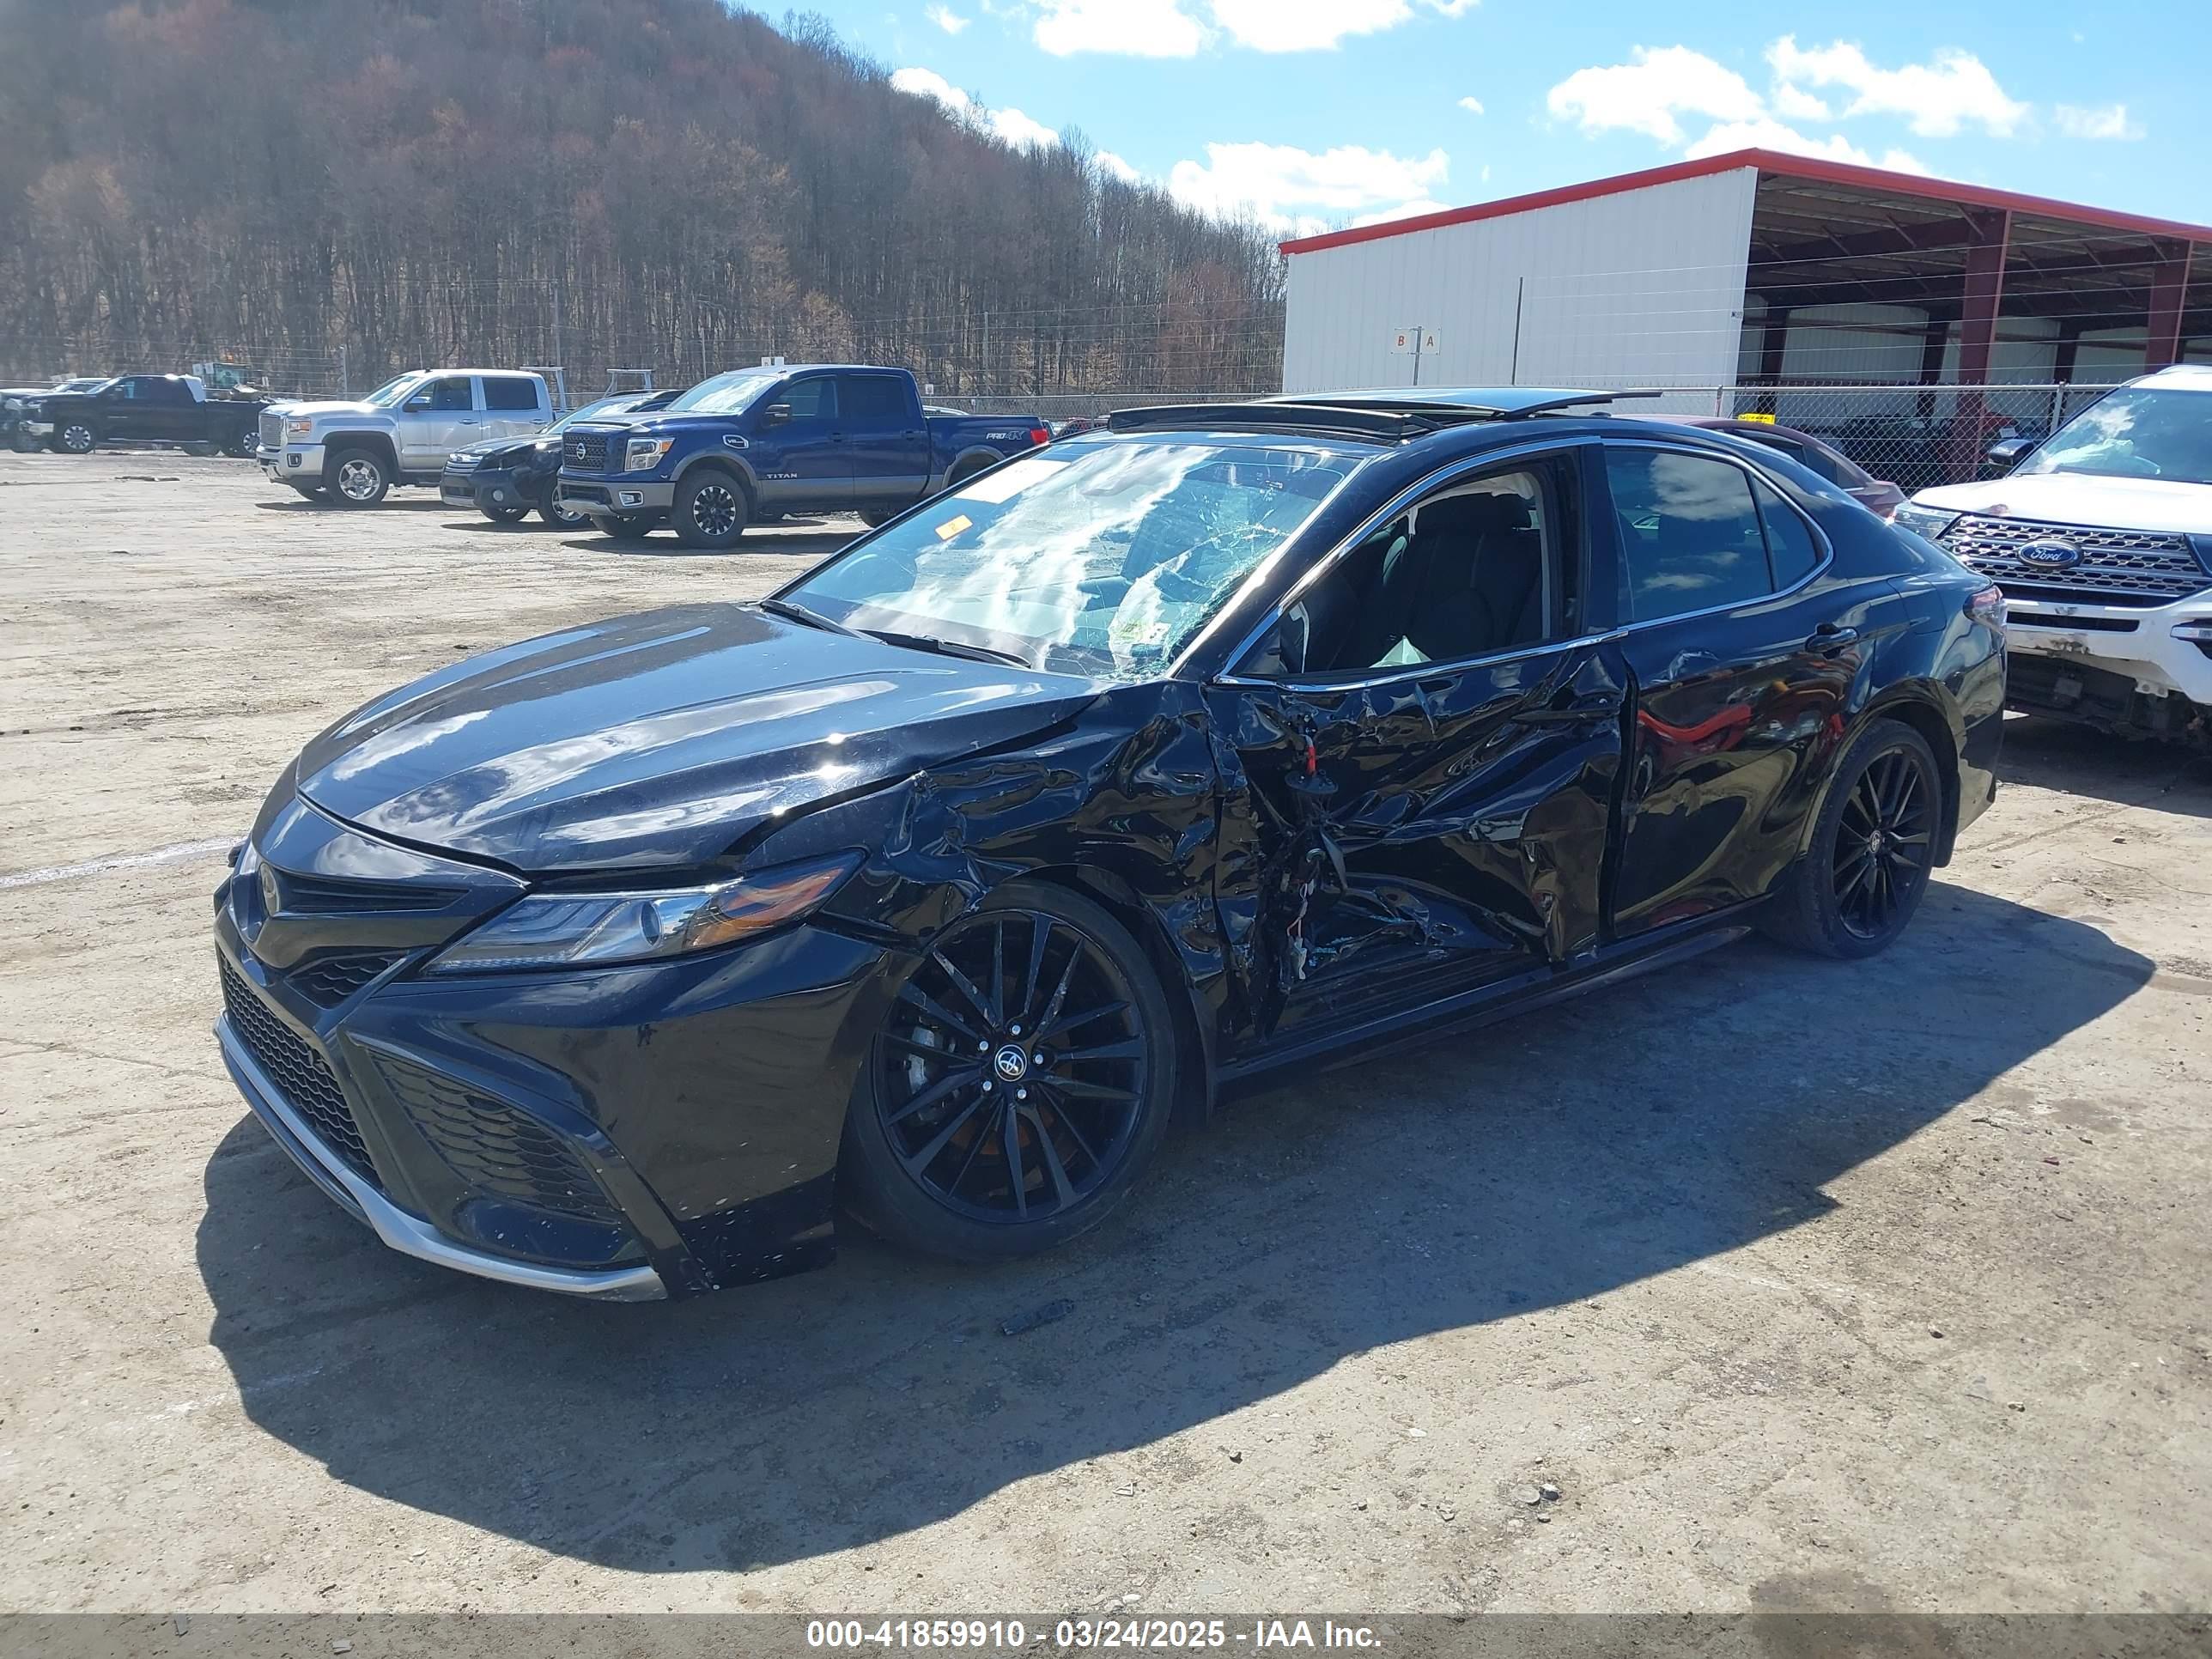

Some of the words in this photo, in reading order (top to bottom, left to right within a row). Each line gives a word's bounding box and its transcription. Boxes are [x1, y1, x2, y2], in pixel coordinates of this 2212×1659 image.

[1398, 335, 1405, 347] B
[1426, 336, 1434, 347] A
[2030, 547, 2063, 561] Ford
